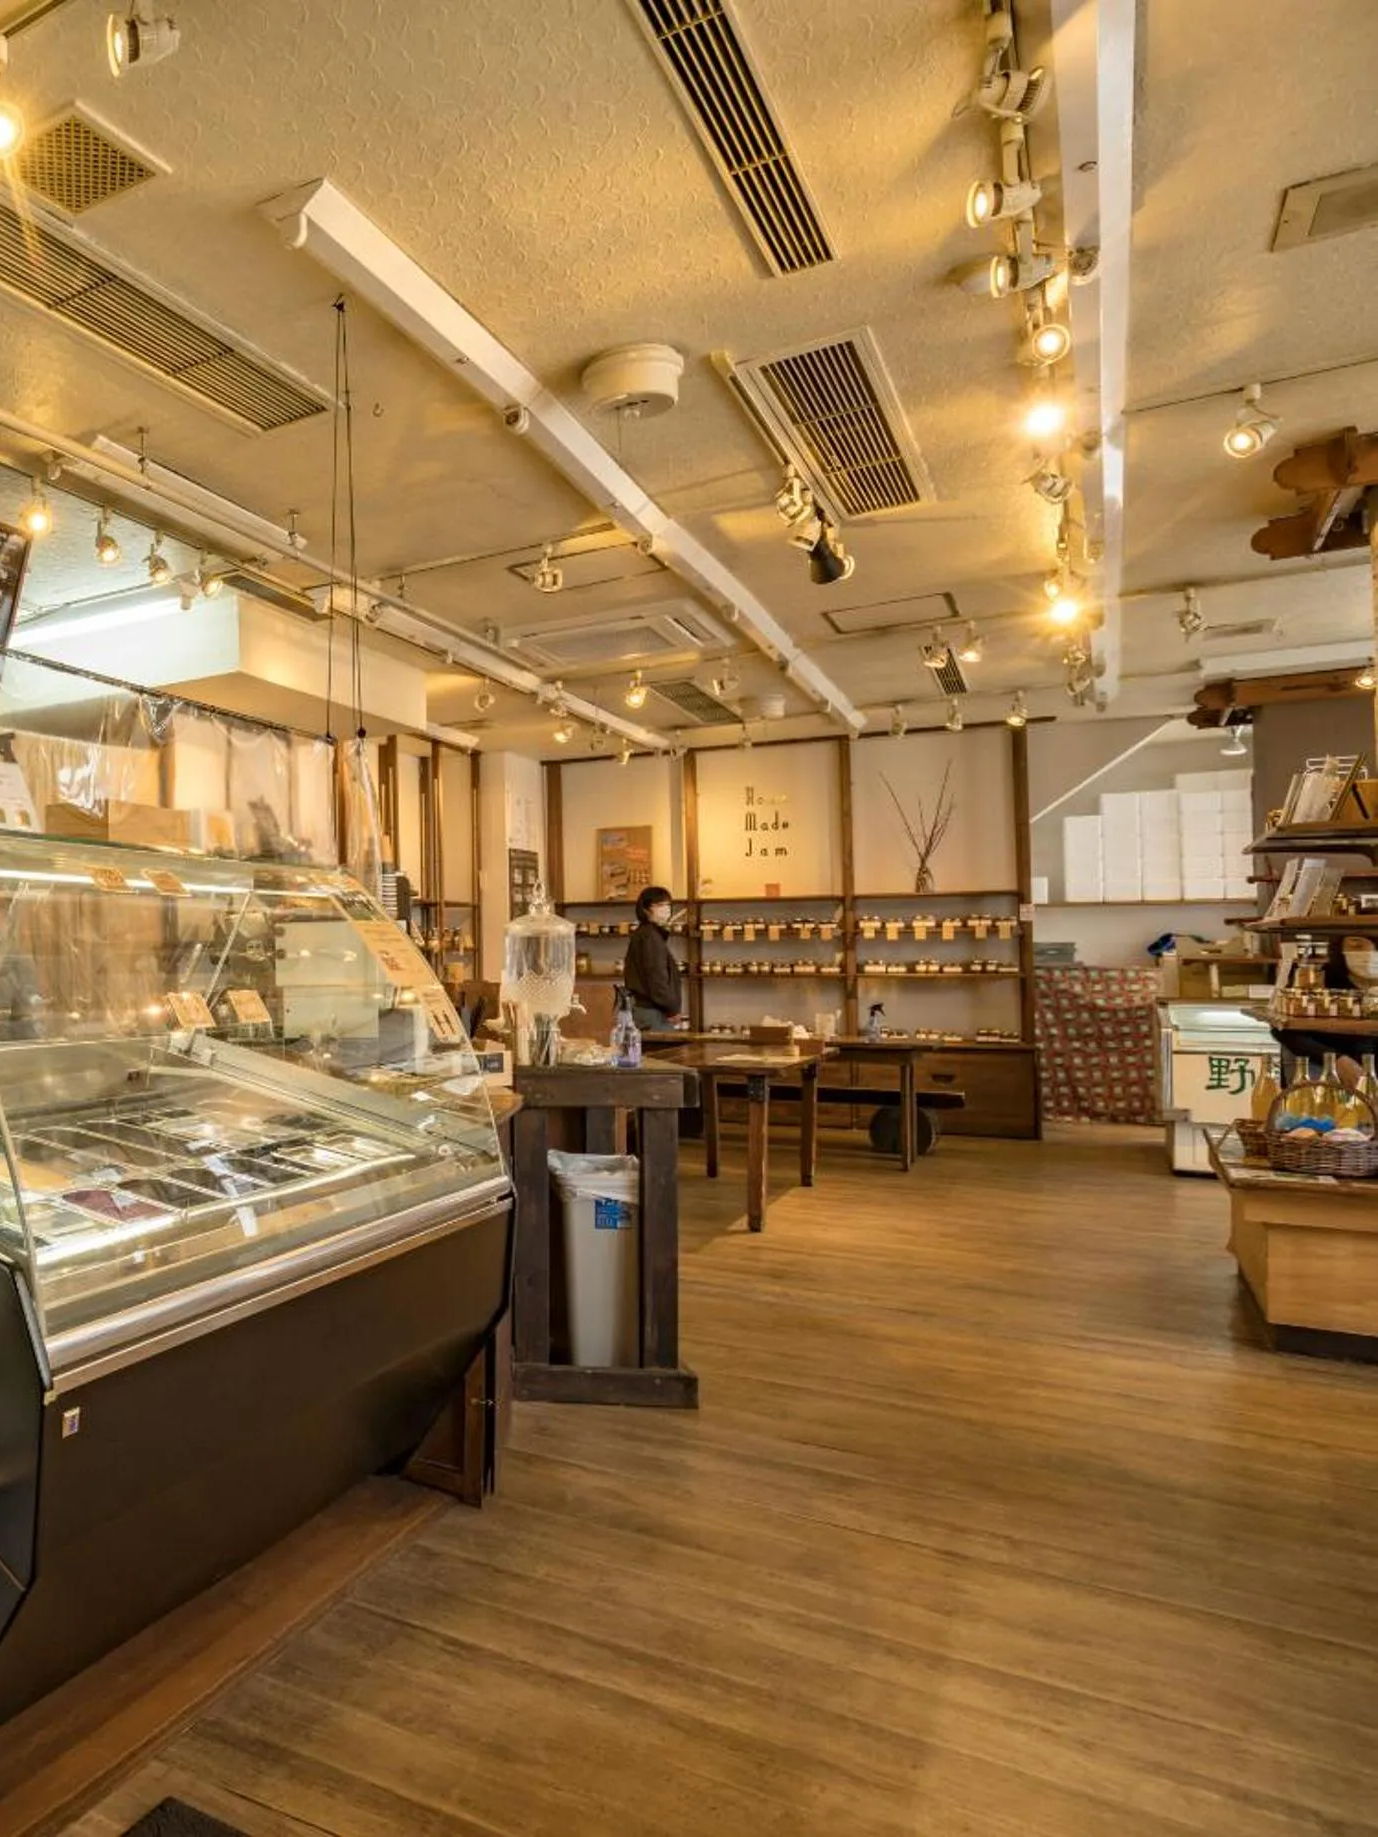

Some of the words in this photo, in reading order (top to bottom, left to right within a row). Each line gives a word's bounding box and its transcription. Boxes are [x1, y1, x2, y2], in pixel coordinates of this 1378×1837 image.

[745, 809, 790, 832] Made
[745, 838, 788, 857] Jam
[1205, 1056, 1256, 1096] 野
